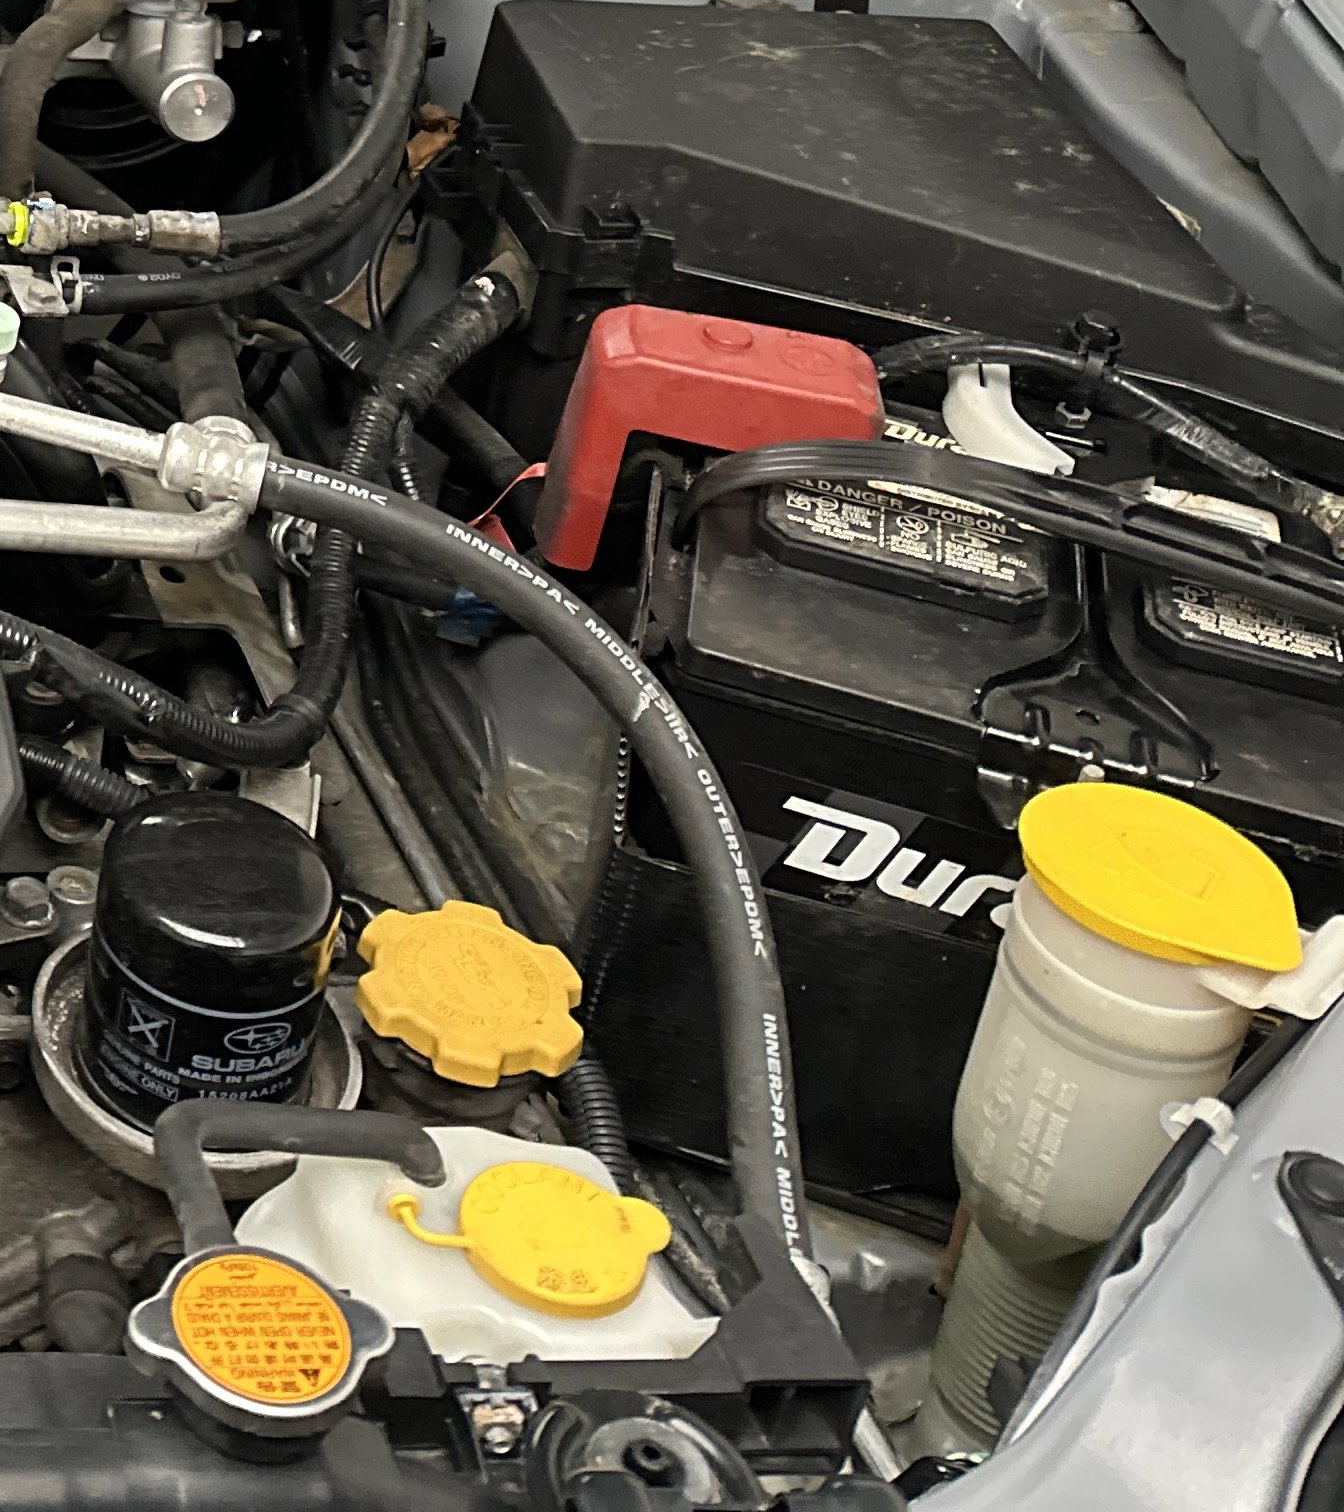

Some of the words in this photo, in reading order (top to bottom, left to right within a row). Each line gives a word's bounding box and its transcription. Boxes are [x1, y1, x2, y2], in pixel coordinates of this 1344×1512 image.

[816, 479, 904, 510] DANGER
[927, 506, 1007, 535] POISON
[177, 1065, 222, 1084] MADE
[225, 1074, 243, 1085] IN
[191, 1327, 216, 1339] HOT
